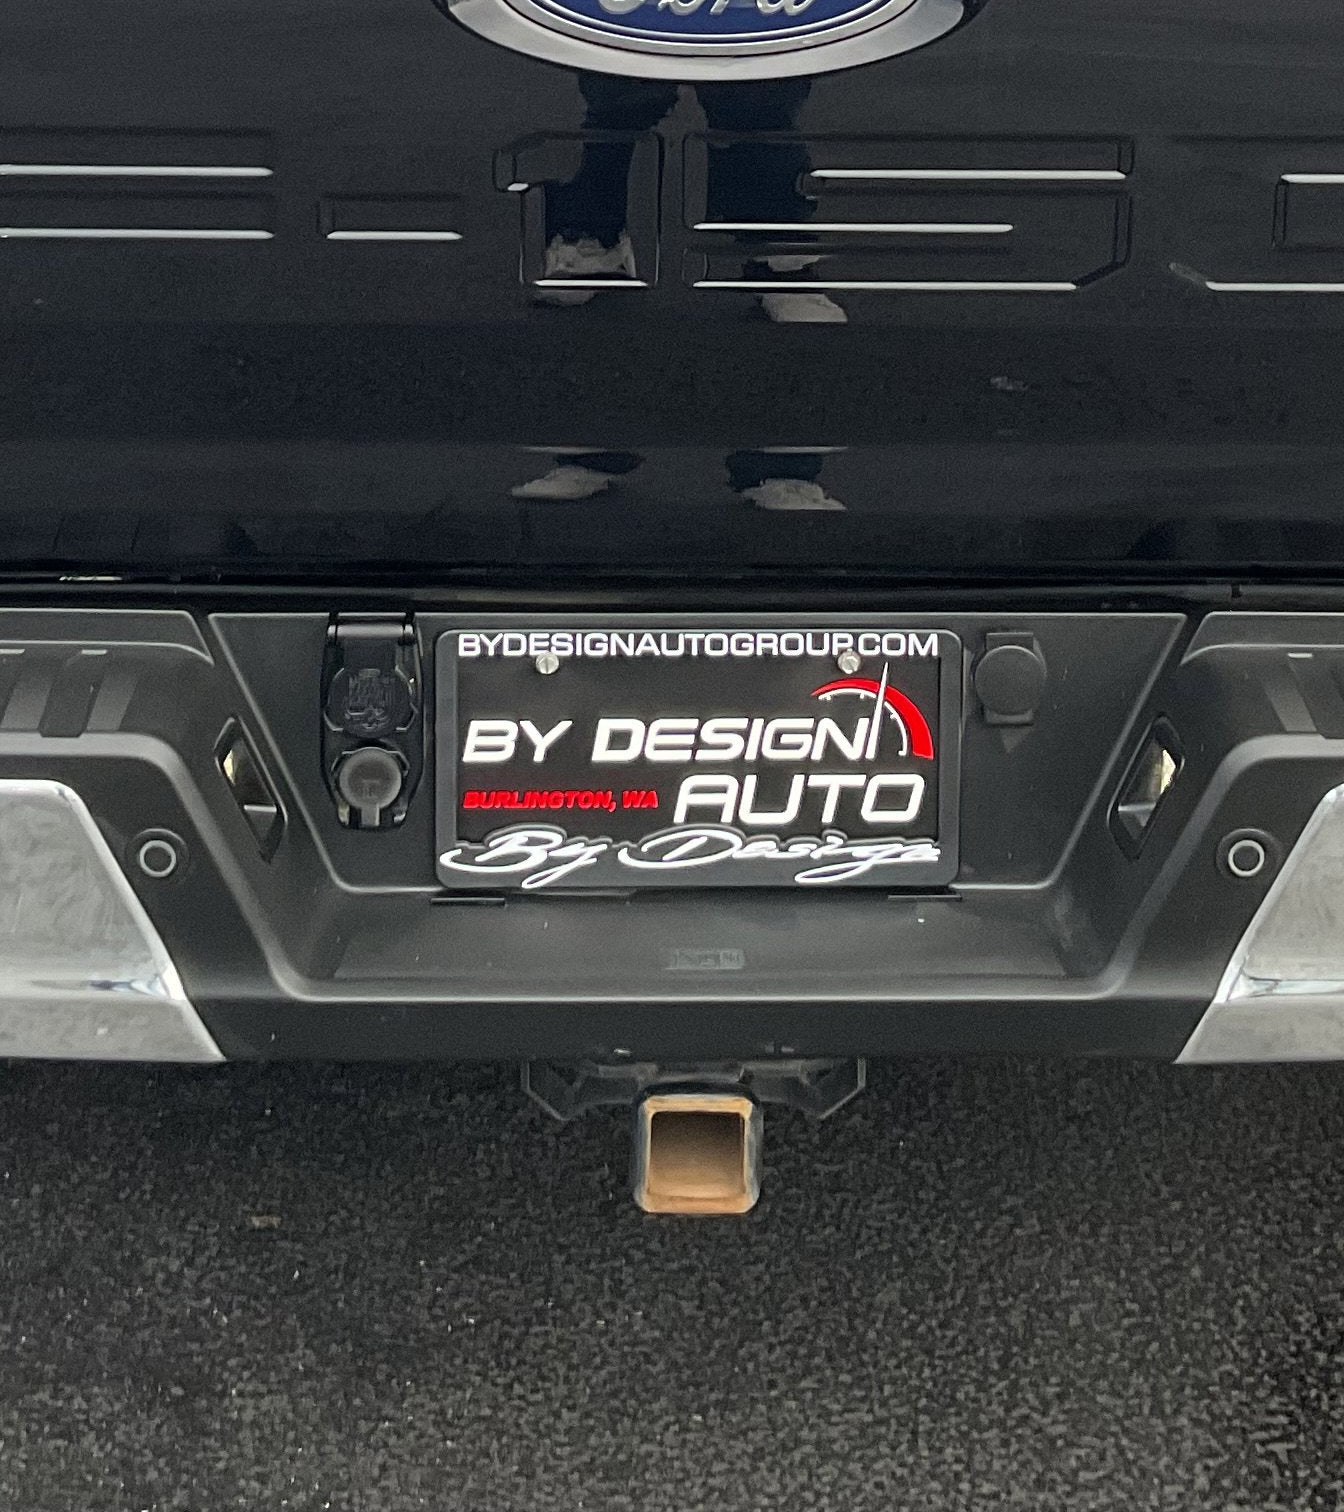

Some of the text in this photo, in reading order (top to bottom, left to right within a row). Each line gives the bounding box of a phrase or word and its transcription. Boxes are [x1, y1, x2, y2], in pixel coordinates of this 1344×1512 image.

[457, 633, 939, 657] BYDESIGNAUTOGROUP.COM
[462, 717, 873, 763] BY DESIGN
[462, 790, 659, 813] BURLINGTON, WA
[673, 773, 927, 825] AUTO
[439, 829, 941, 890] By Design
